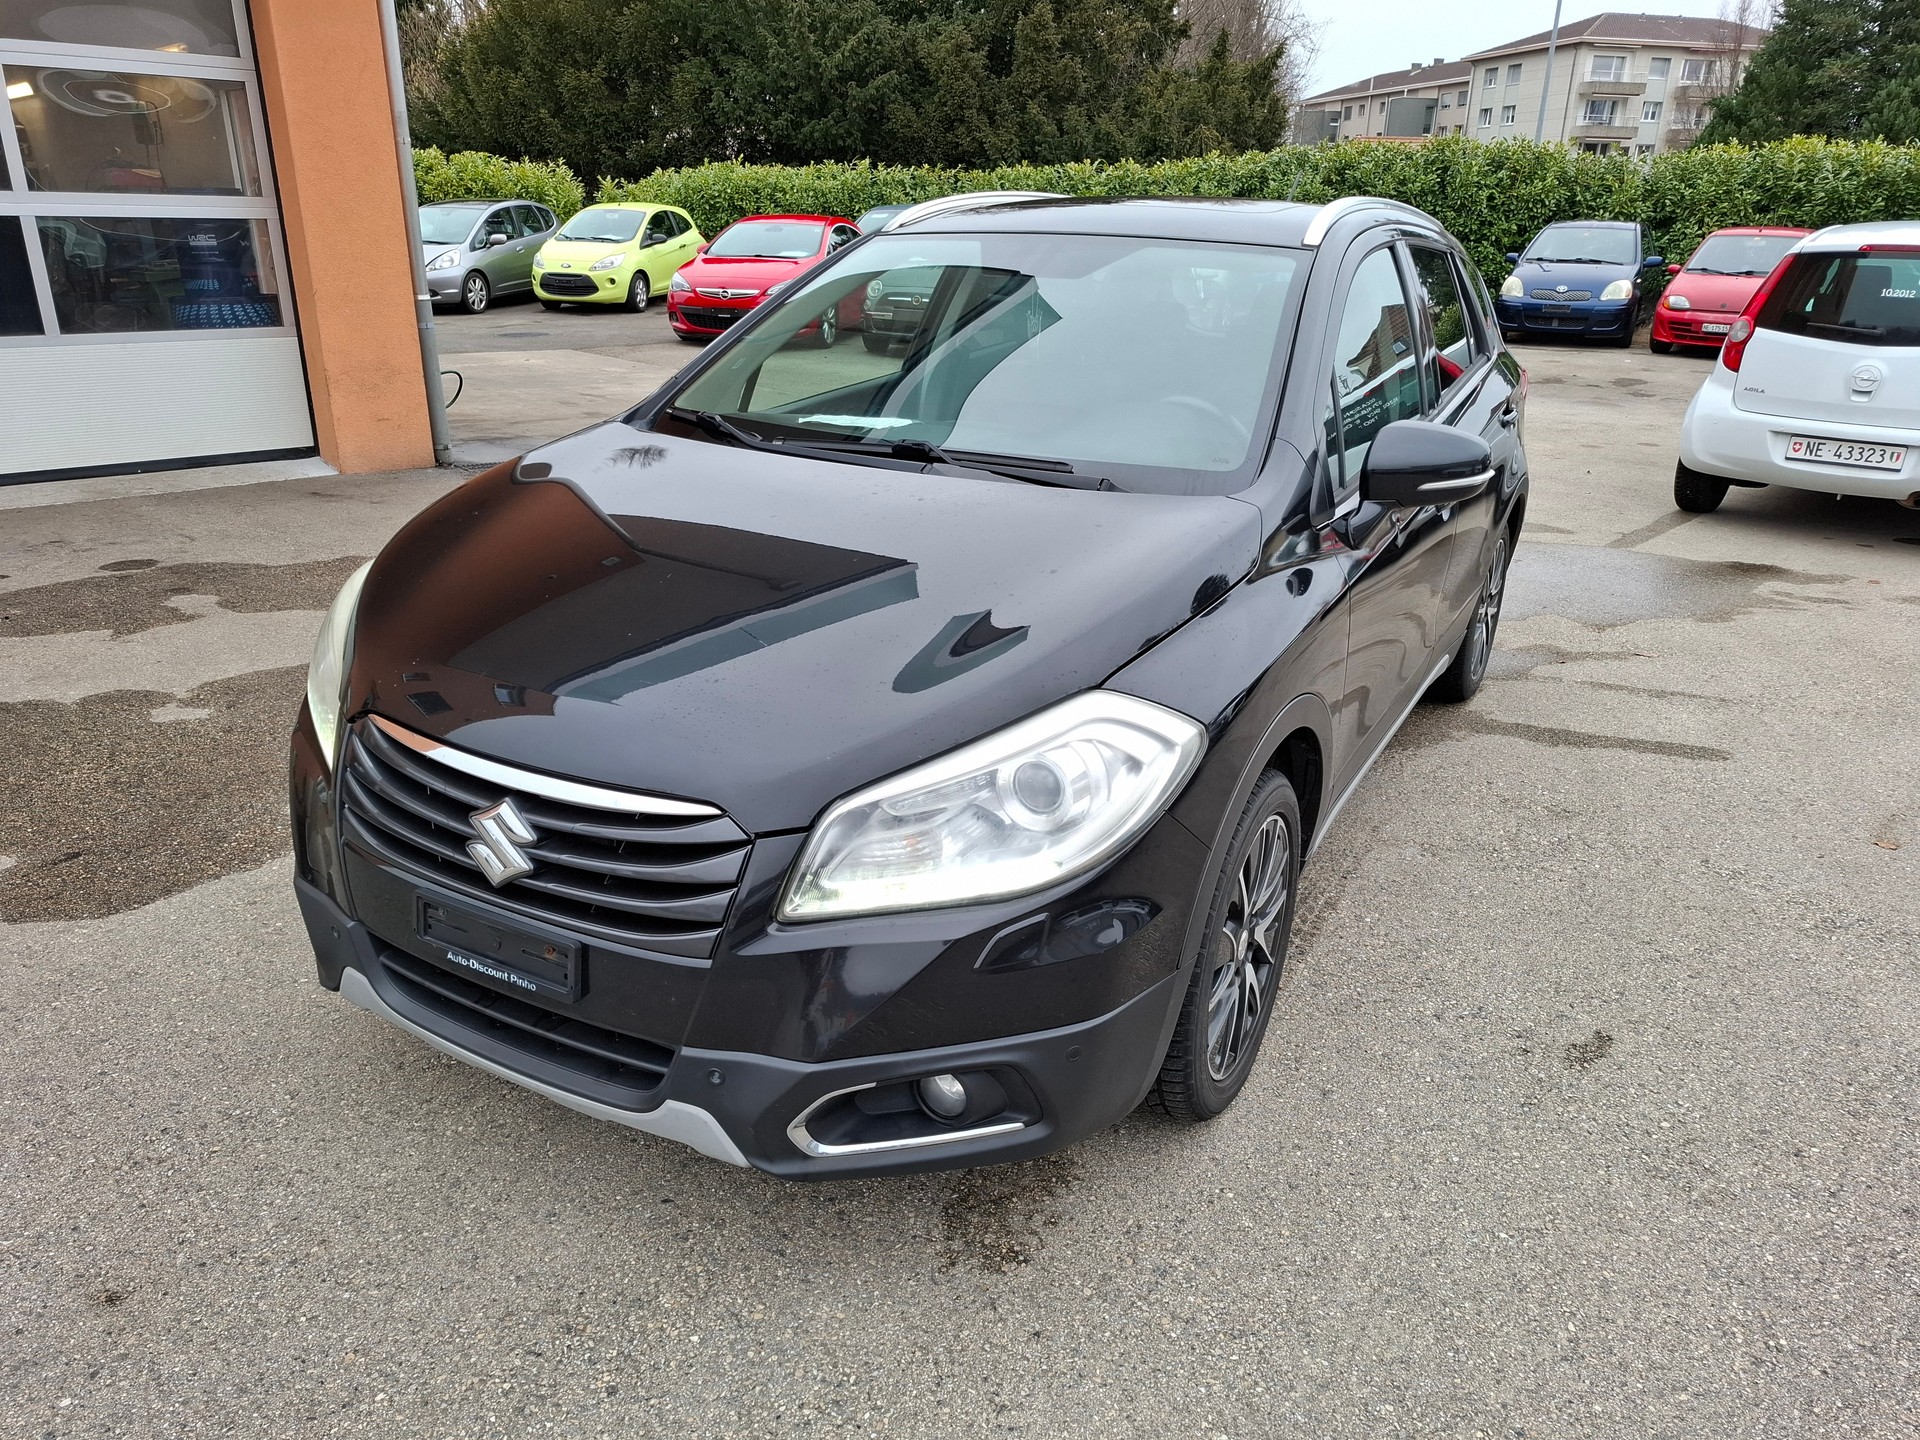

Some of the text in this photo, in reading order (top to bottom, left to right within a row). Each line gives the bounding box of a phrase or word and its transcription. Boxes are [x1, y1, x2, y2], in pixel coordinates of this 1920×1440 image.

[1880, 288, 1916, 299] 10.2012
[1804, 441, 1887, 464] NE 43323
[446, 951, 537, 992] Auto-Discount Pinho
